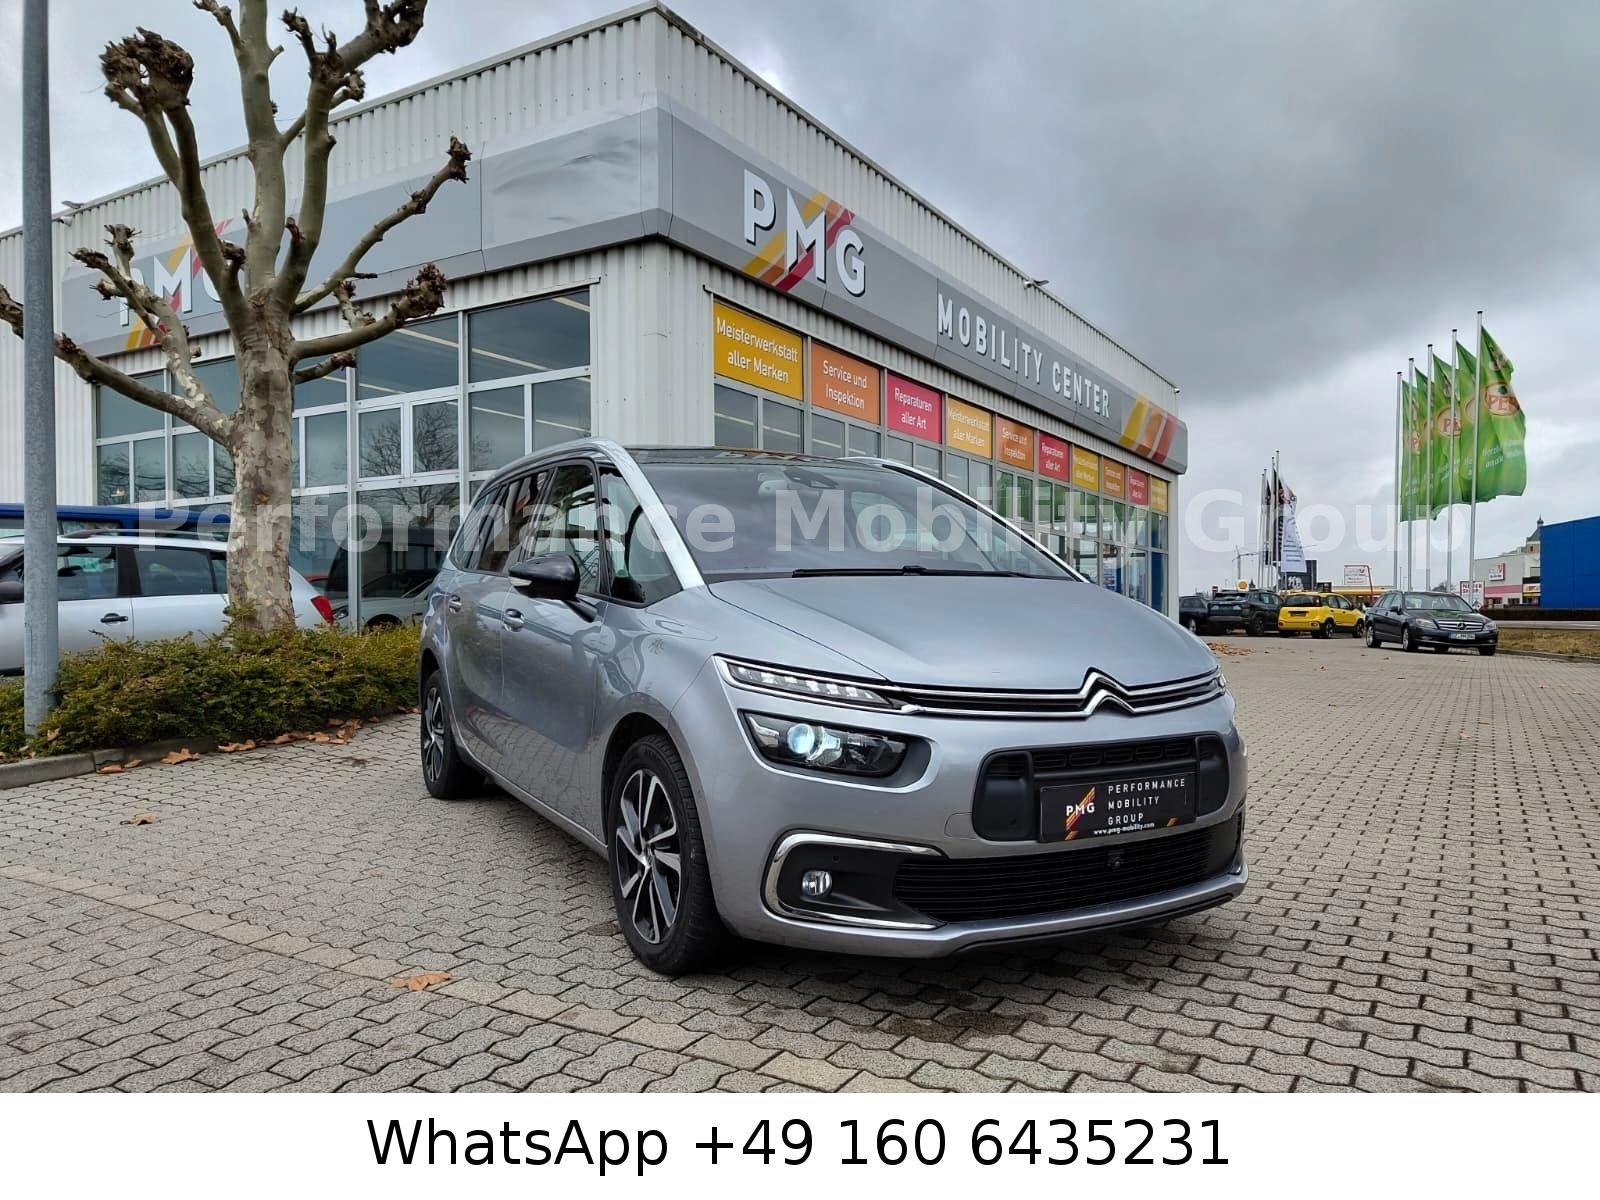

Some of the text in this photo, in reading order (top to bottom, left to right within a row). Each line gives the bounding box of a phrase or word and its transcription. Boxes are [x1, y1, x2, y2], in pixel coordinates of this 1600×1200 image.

[743, 169, 866, 297] PMG
[716, 317, 798, 363] Meisterwerkstatt
[727, 350, 789, 384] aller Marken
[938, 293, 1111, 419] MOBILITY CENTER
[823, 359, 868, 390] Service und
[825, 383, 865, 410] Inspektion
[894, 387, 933, 412] Reparaturen
[901, 411, 928, 430] aller Art
[1108, 778, 1186, 795] PERFORMANCE
[1066, 802, 1096, 817] PMG
[1108, 796, 1160, 811] MOBILITY
[1094, 821, 1155, 836] www.pmg-mobility.com
[1108, 813, 1145, 826] GROUP
